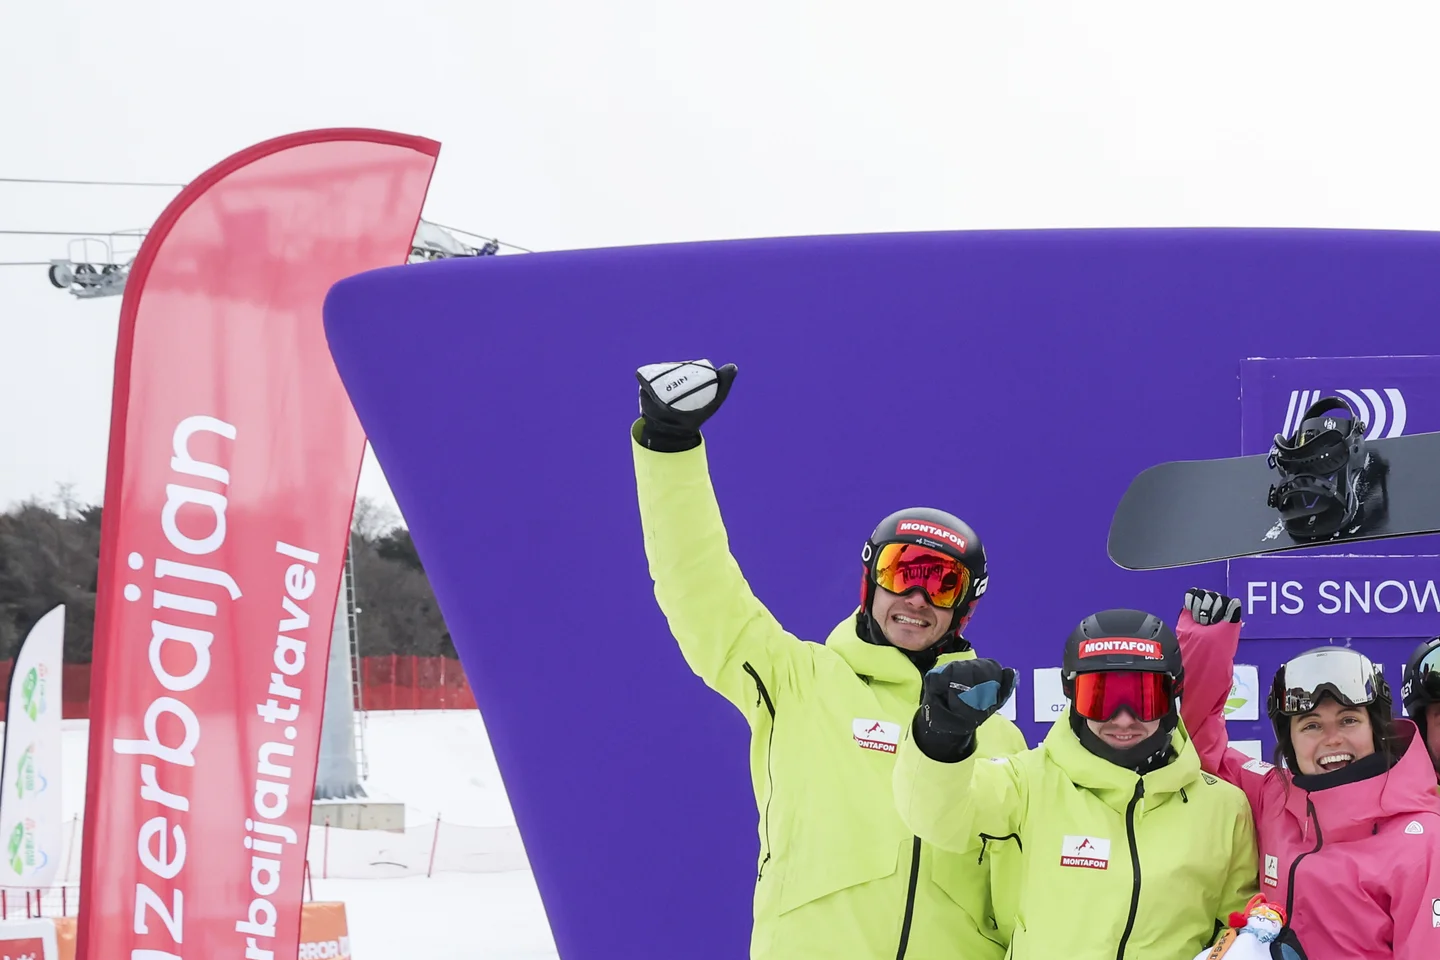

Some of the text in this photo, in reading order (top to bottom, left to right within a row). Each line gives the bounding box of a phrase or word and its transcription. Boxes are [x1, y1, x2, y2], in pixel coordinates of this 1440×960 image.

[900, 522, 966, 549] MONTAFON
[1247, 580, 1304, 614] FIS
[1085, 641, 1154, 653] MONTAFON
[1062, 857, 1107, 868] MONTAFON
